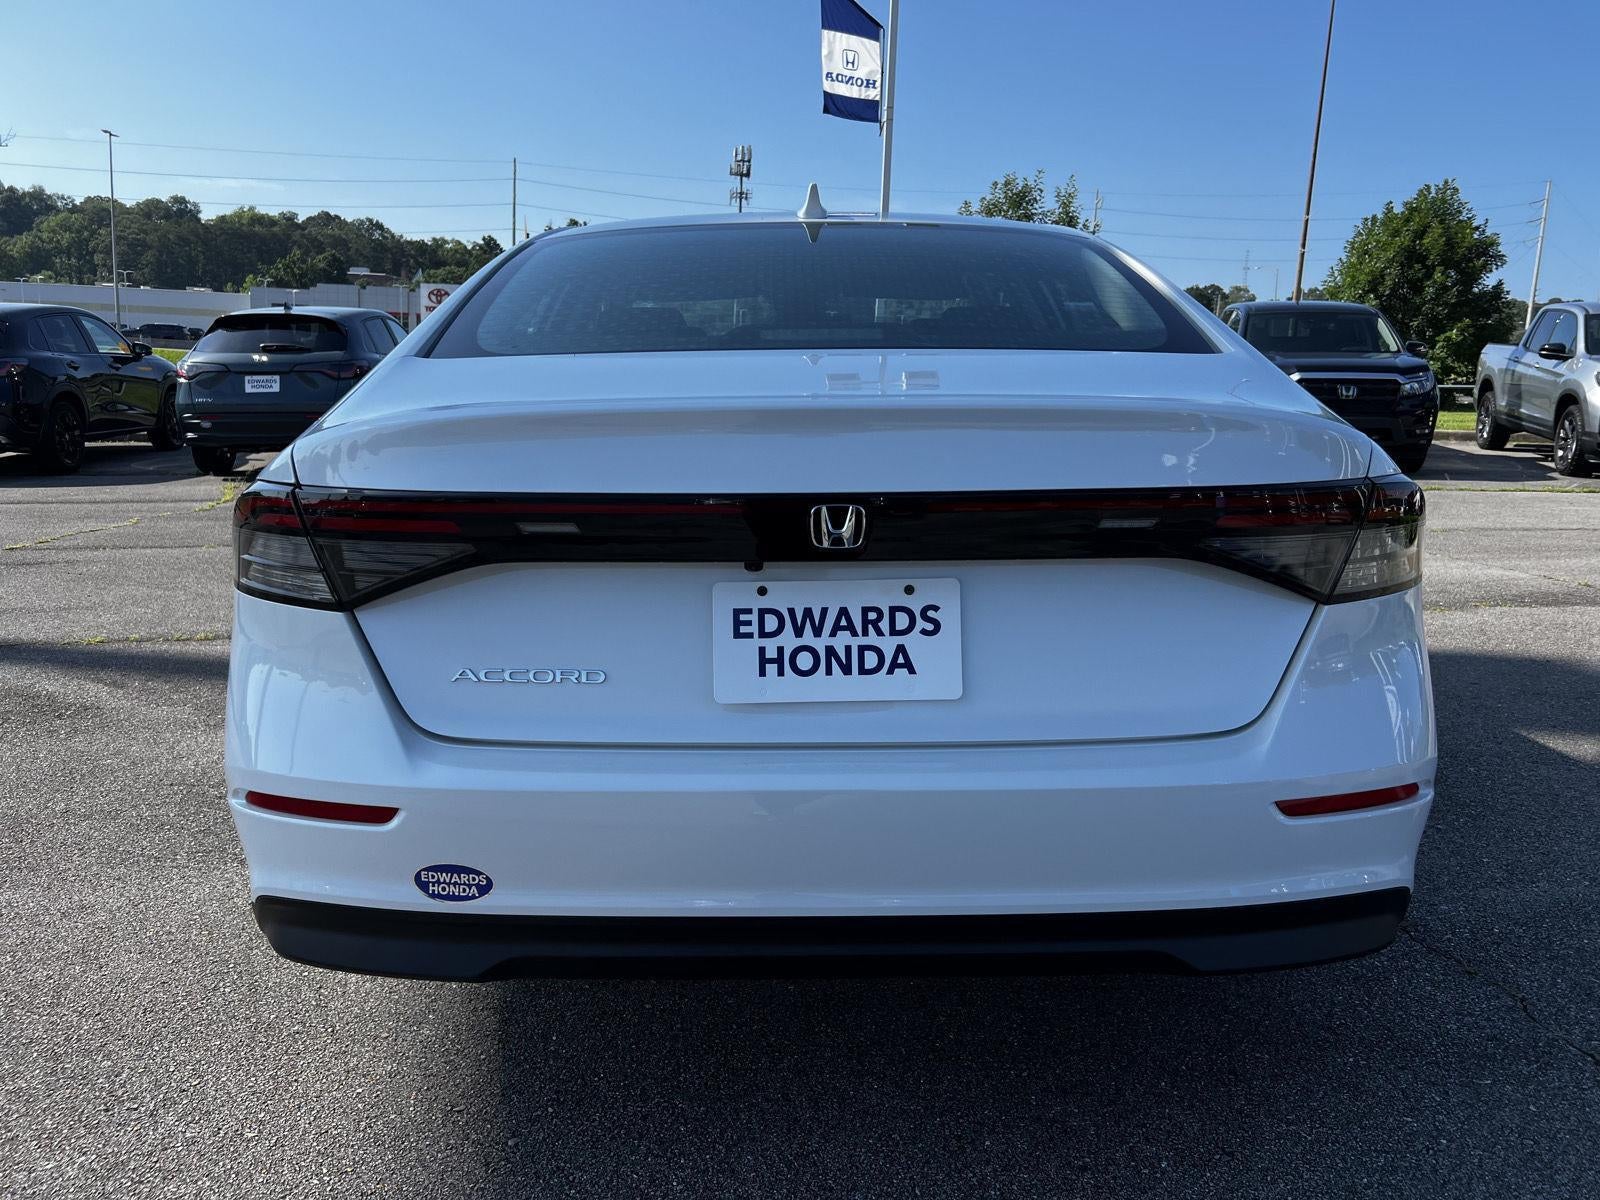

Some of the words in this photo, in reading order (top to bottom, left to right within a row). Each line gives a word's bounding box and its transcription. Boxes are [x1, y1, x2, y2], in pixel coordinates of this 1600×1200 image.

[732, 604, 942, 639] EDWARDS
[758, 643, 917, 678] HONDA
[450, 667, 607, 684] ACCORD
[420, 871, 487, 885] EDWARDS
[428, 883, 479, 897] HONDA
